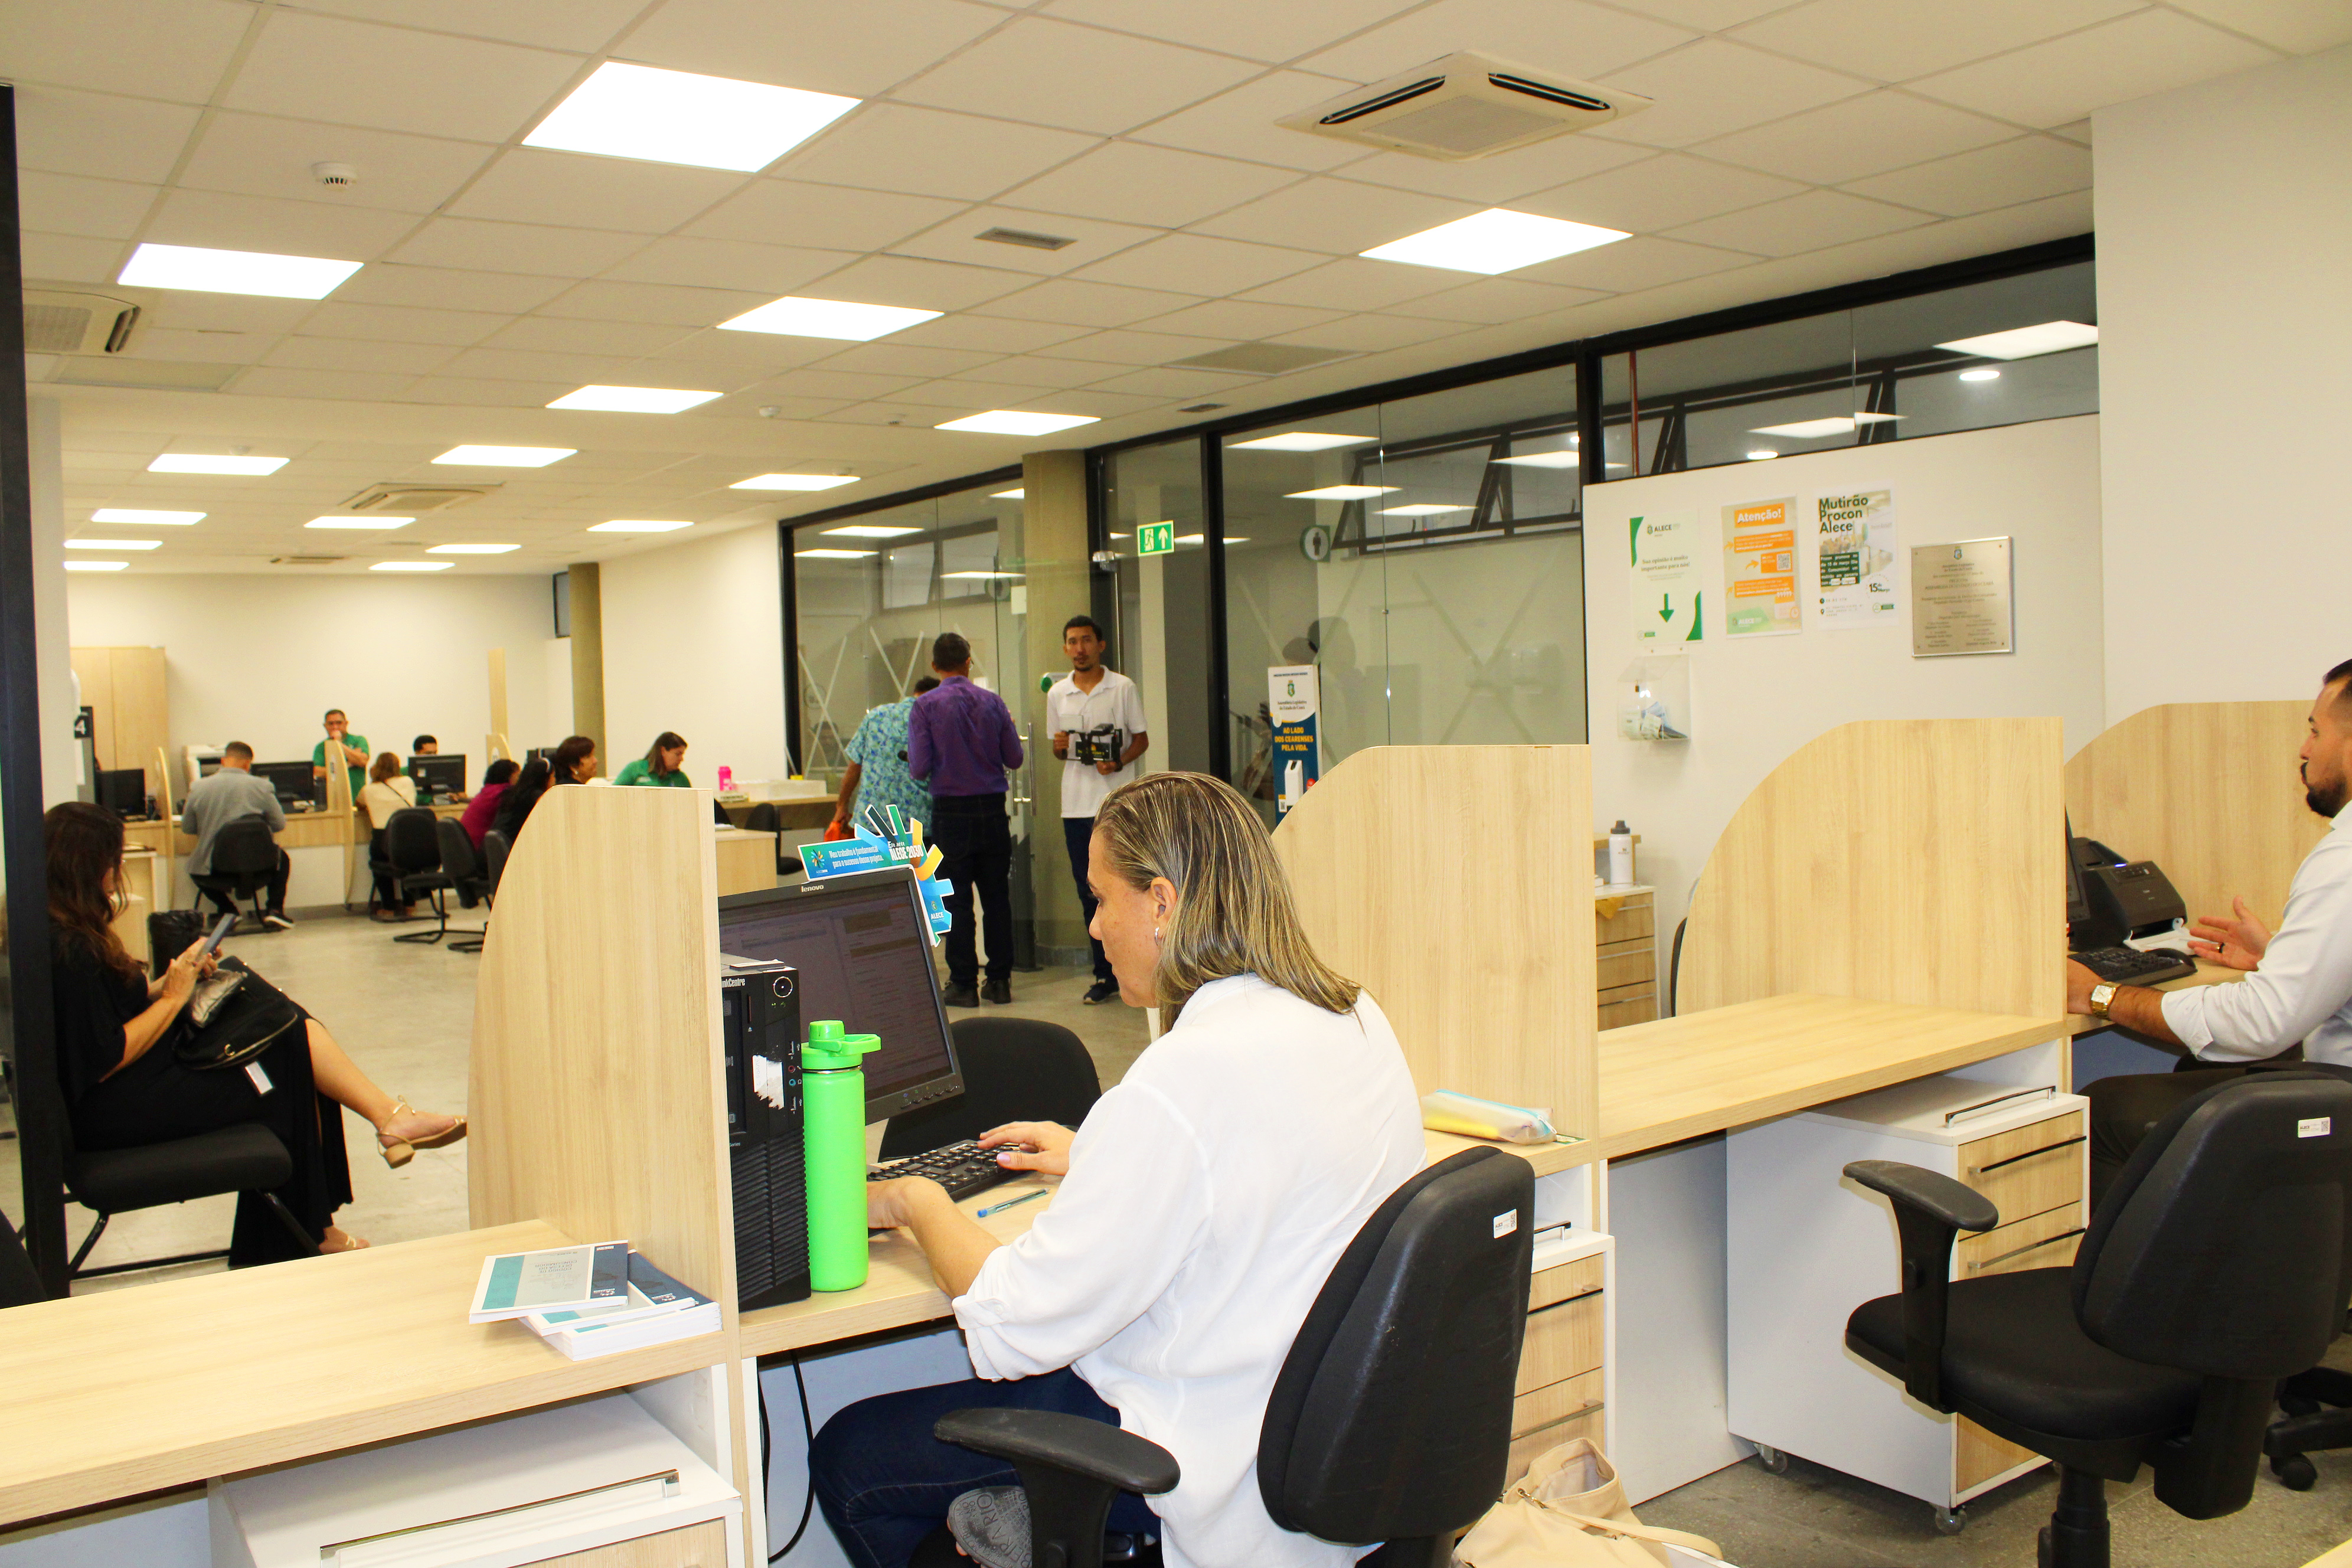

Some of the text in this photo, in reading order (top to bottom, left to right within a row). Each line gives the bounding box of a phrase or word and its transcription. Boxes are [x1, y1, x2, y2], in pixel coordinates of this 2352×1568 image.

[1819, 494, 1868, 511] Mutirão
[1737, 507, 1782, 524] Atenção!
[1819, 509, 1863, 522] Procon
[1819, 520, 1853, 534] Alece
[1869, 583, 1878, 592] 15
[829, 850, 838, 858] Meu
[837, 848, 854, 857] trabalho
[855, 845, 879, 857] fundamental
[889, 844, 924, 861] ALECE 2030
[832, 860, 842, 869] para
[844, 858, 860, 866] sucesso
[858, 856, 870, 864] desse
[869, 854, 884, 864] projeto.
[721, 978, 746, 988] inkCentre
[977, 1494, 999, 1525] RIO
